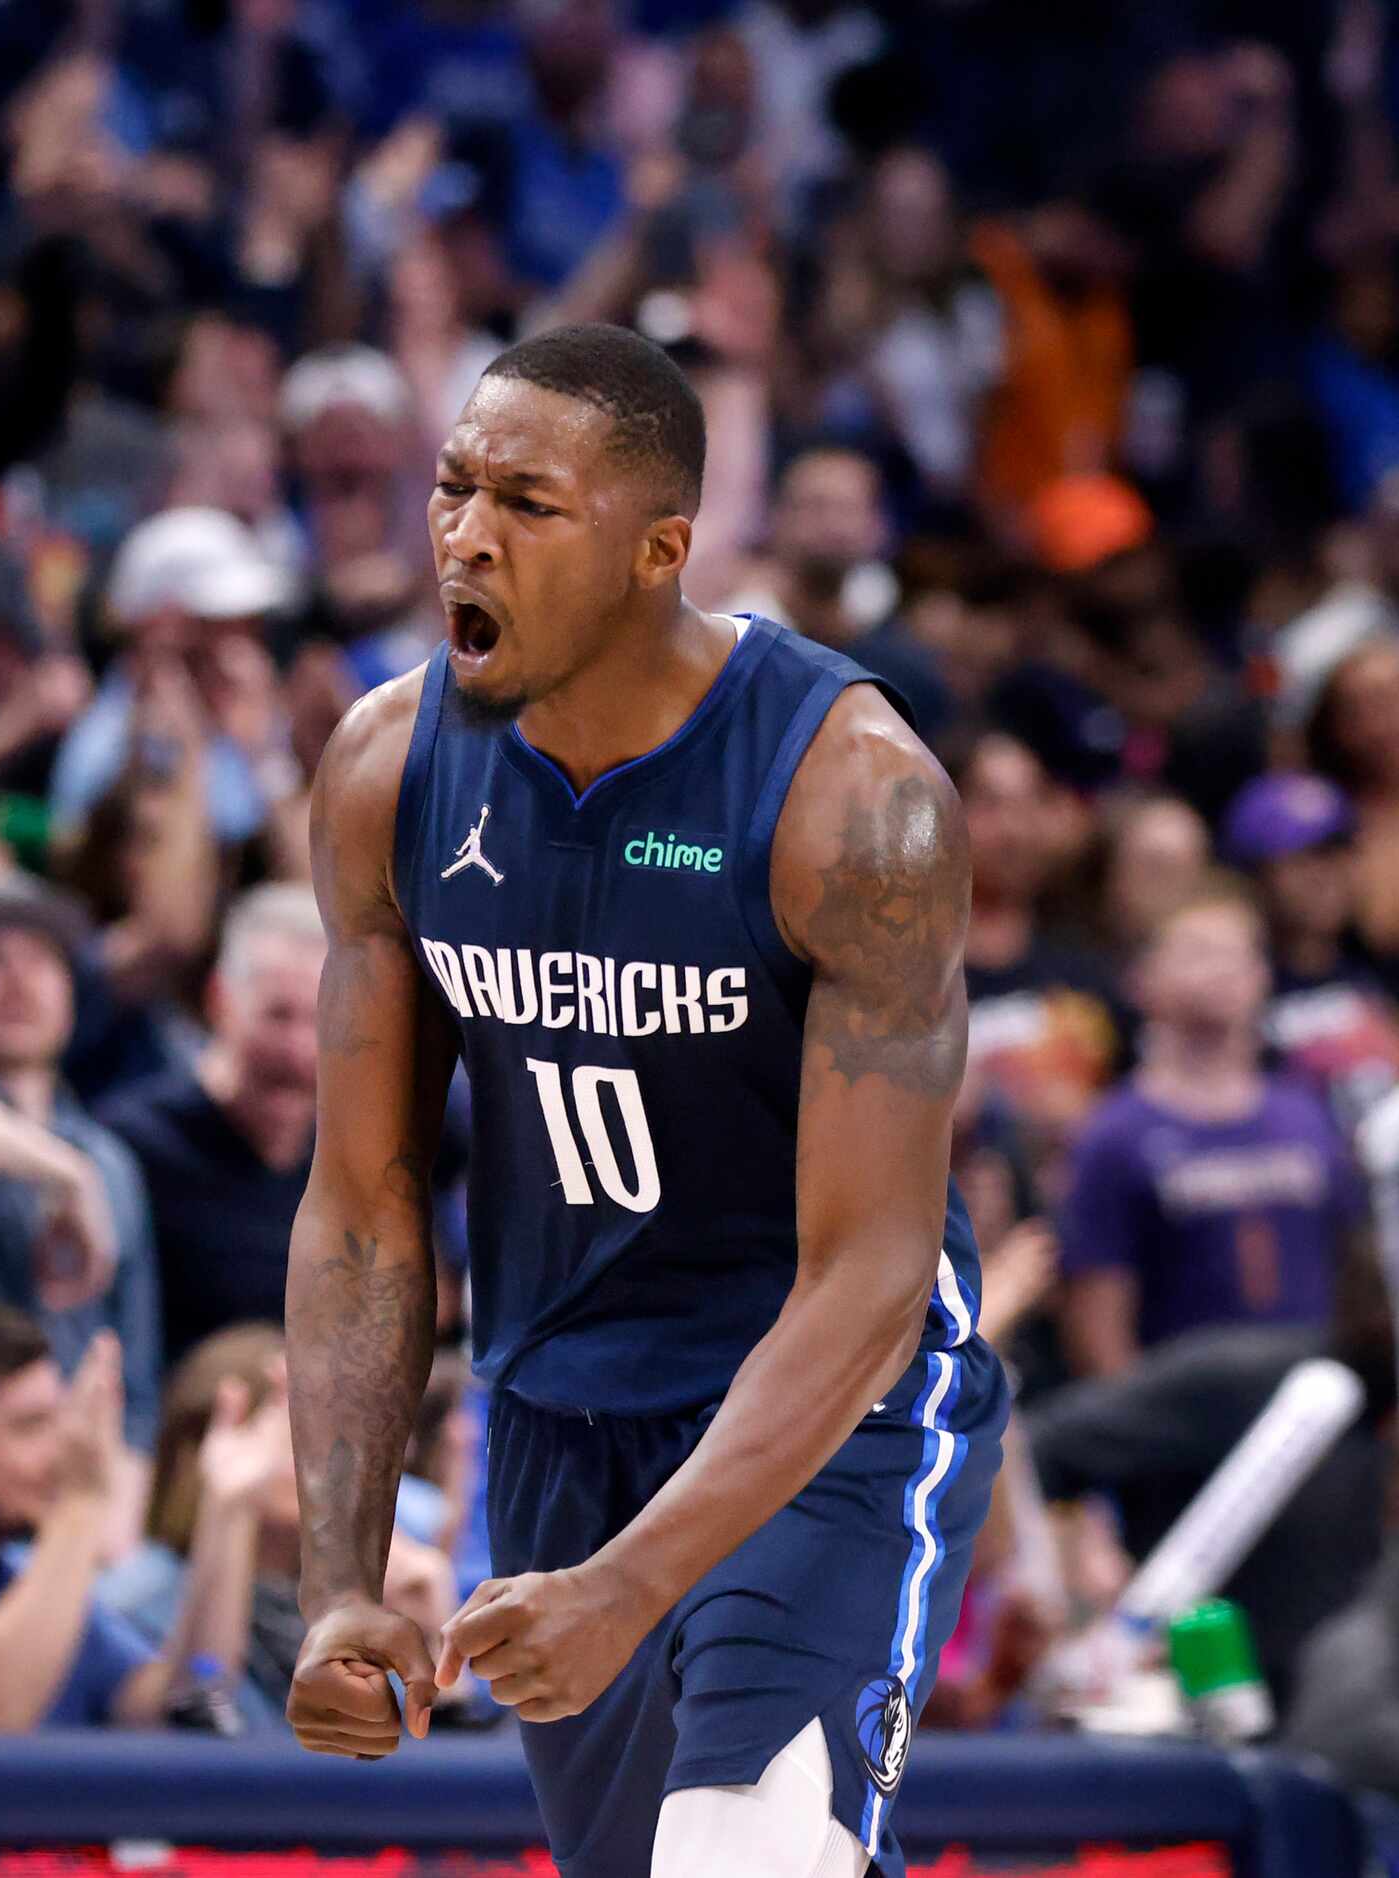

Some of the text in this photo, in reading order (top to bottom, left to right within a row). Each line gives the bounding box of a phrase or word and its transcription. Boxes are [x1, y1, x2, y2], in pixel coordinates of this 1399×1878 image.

[624, 831, 723, 873] chime
[420, 936, 749, 1037] MAVERICKS
[526, 1057, 661, 1213] 10
